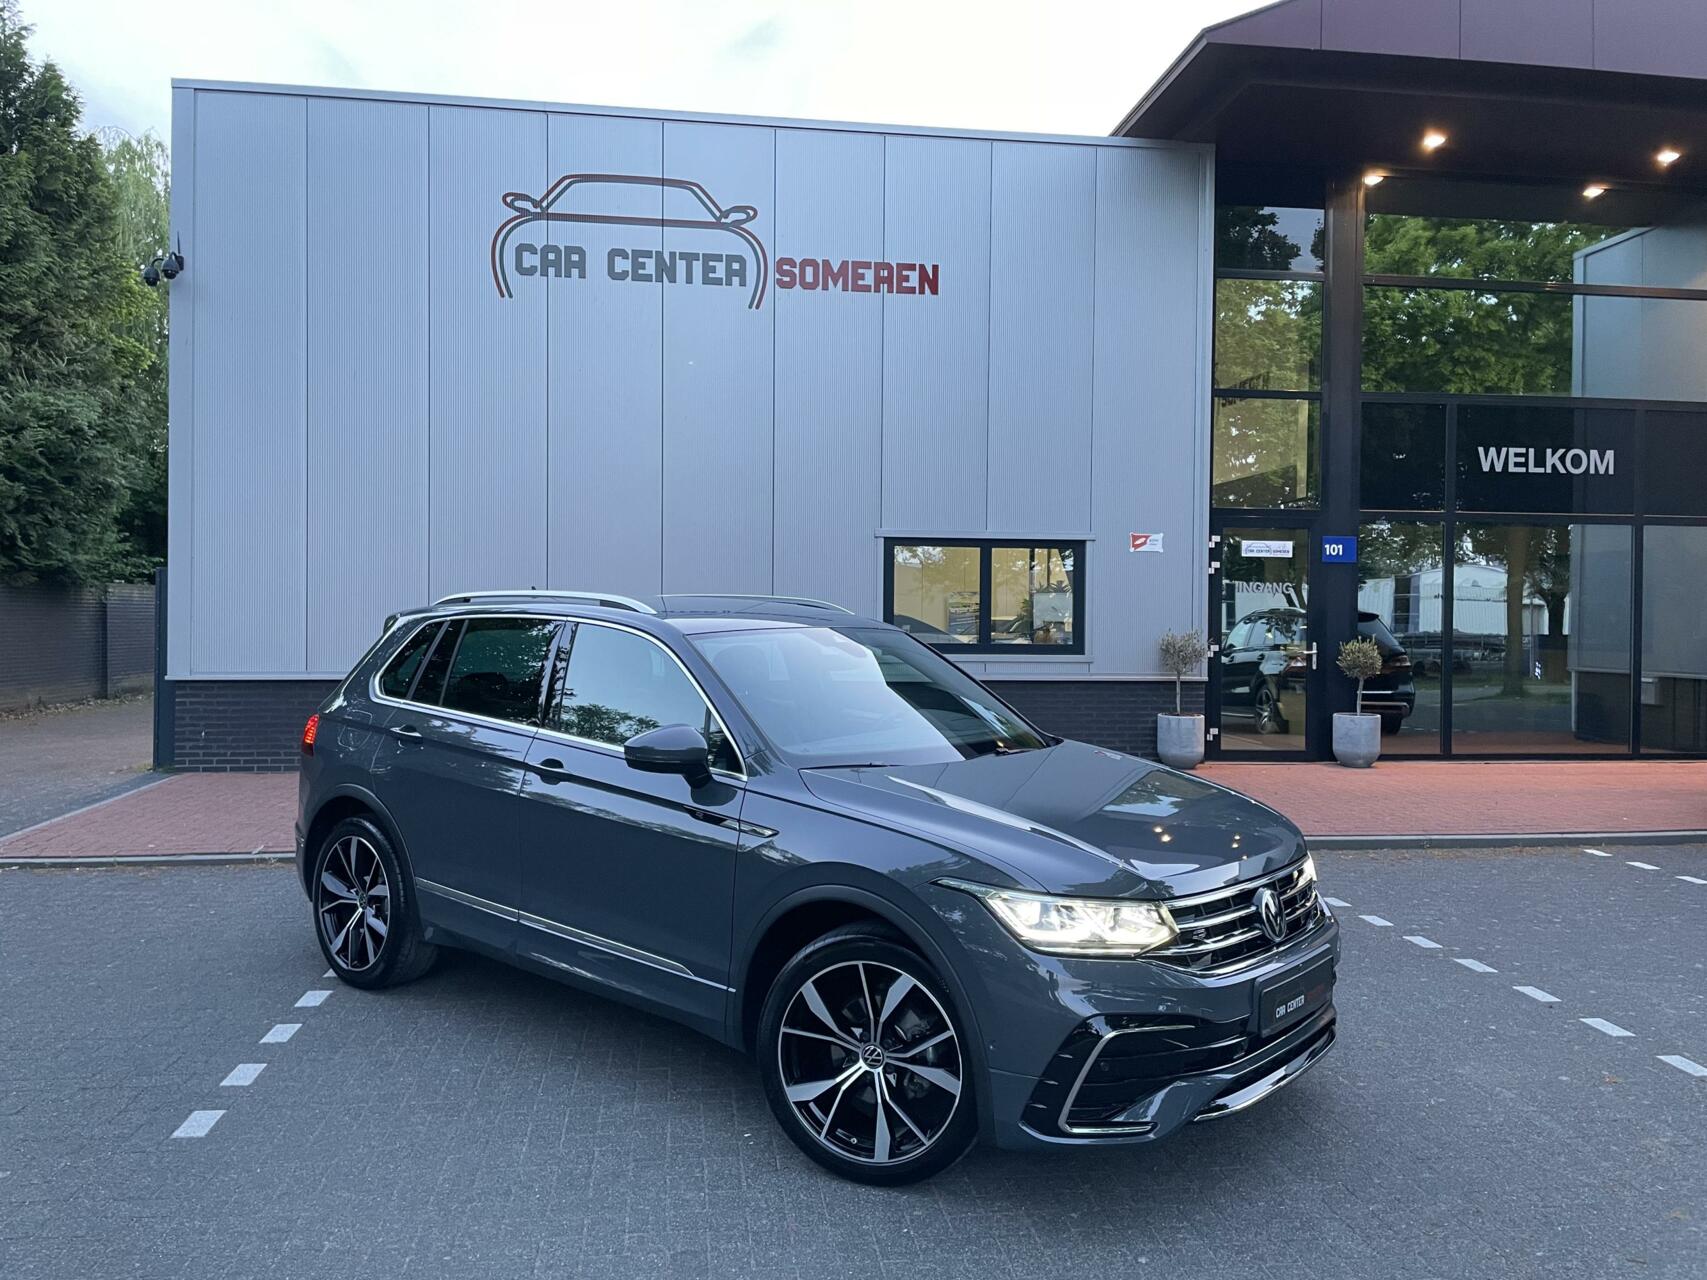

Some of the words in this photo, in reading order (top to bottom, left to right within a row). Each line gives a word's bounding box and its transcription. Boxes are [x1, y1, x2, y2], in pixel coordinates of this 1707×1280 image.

[514, 243, 586, 279] CAR
[607, 248, 747, 287] CENTER
[775, 257, 939, 296] SOMEREN
[1477, 446, 1615, 475] WELKOM
[1324, 544, 1343, 556] 101
[1275, 1004, 1286, 1019] CAR
[1287, 994, 1305, 1013] CENTER
